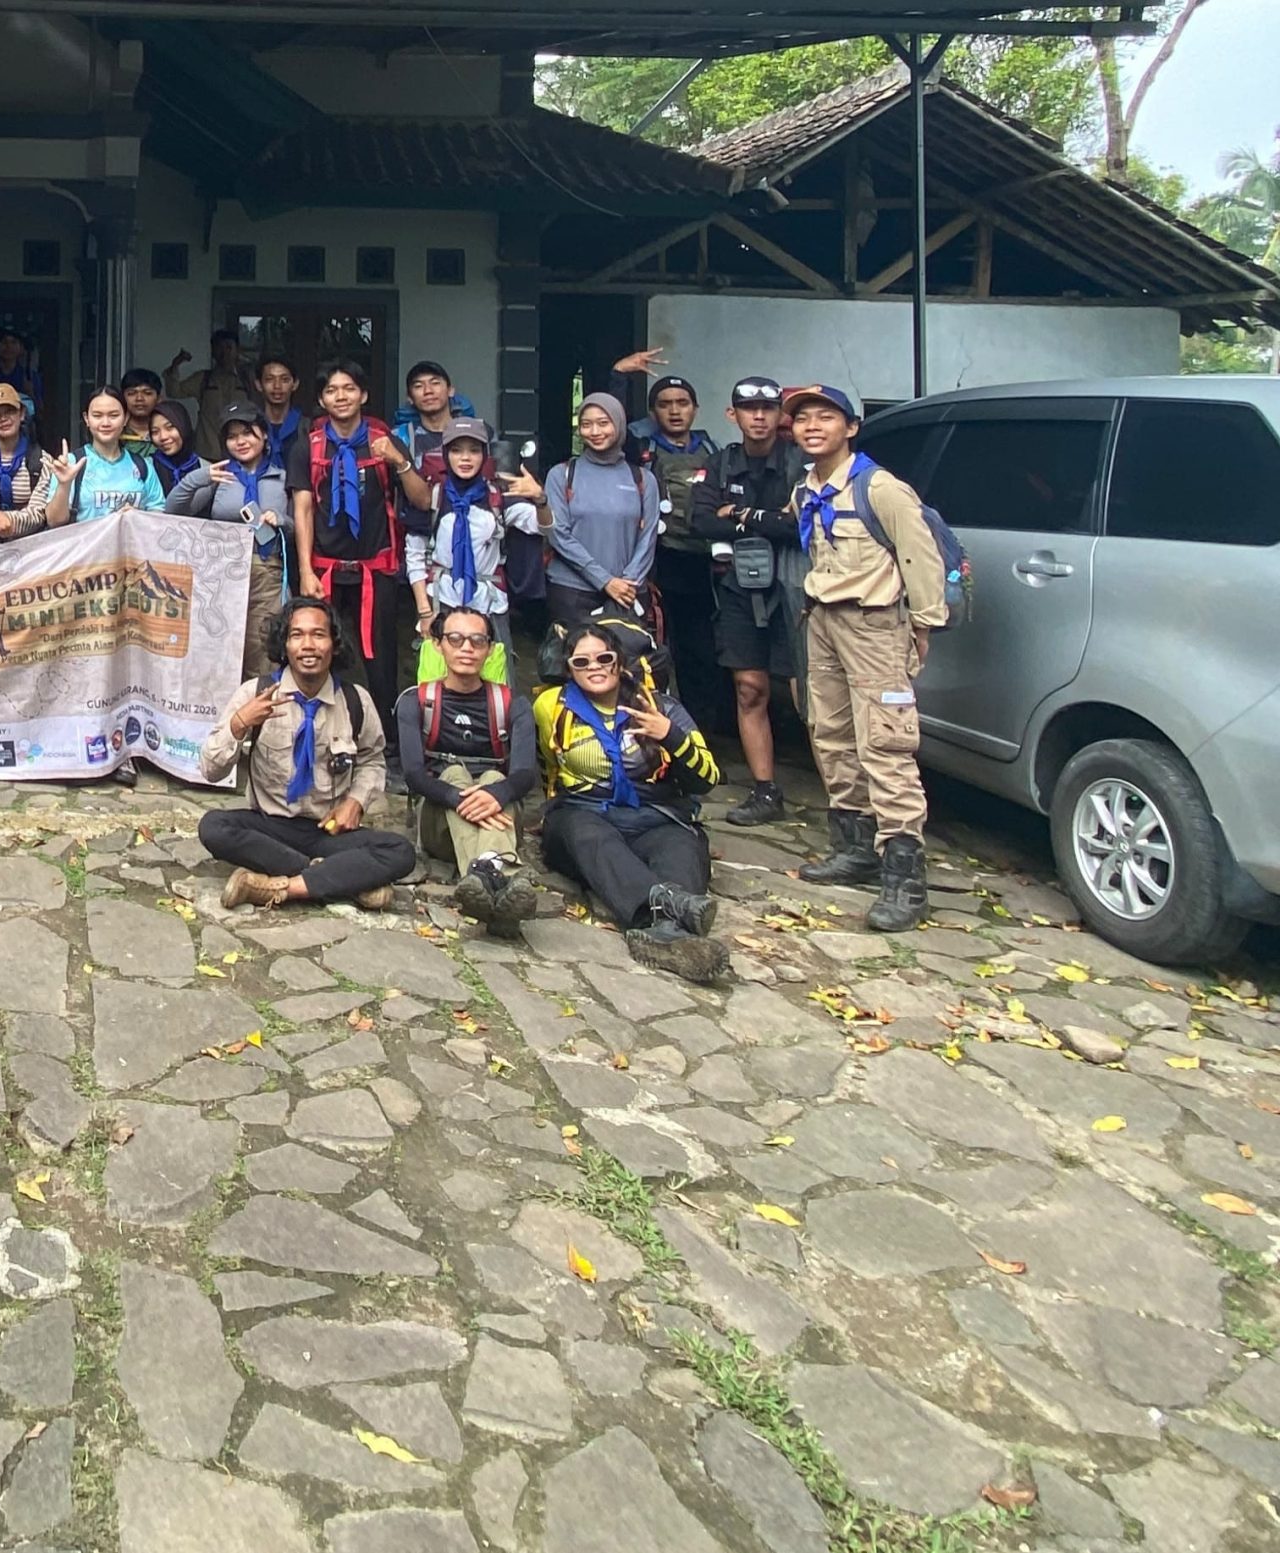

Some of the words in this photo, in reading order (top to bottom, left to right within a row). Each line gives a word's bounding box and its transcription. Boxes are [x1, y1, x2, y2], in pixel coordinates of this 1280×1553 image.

[5, 572, 119, 608] EDUCAMP
[7, 606, 65, 631] MINI
[168, 700, 192, 713] JUNI
[194, 704, 217, 715] 2026
